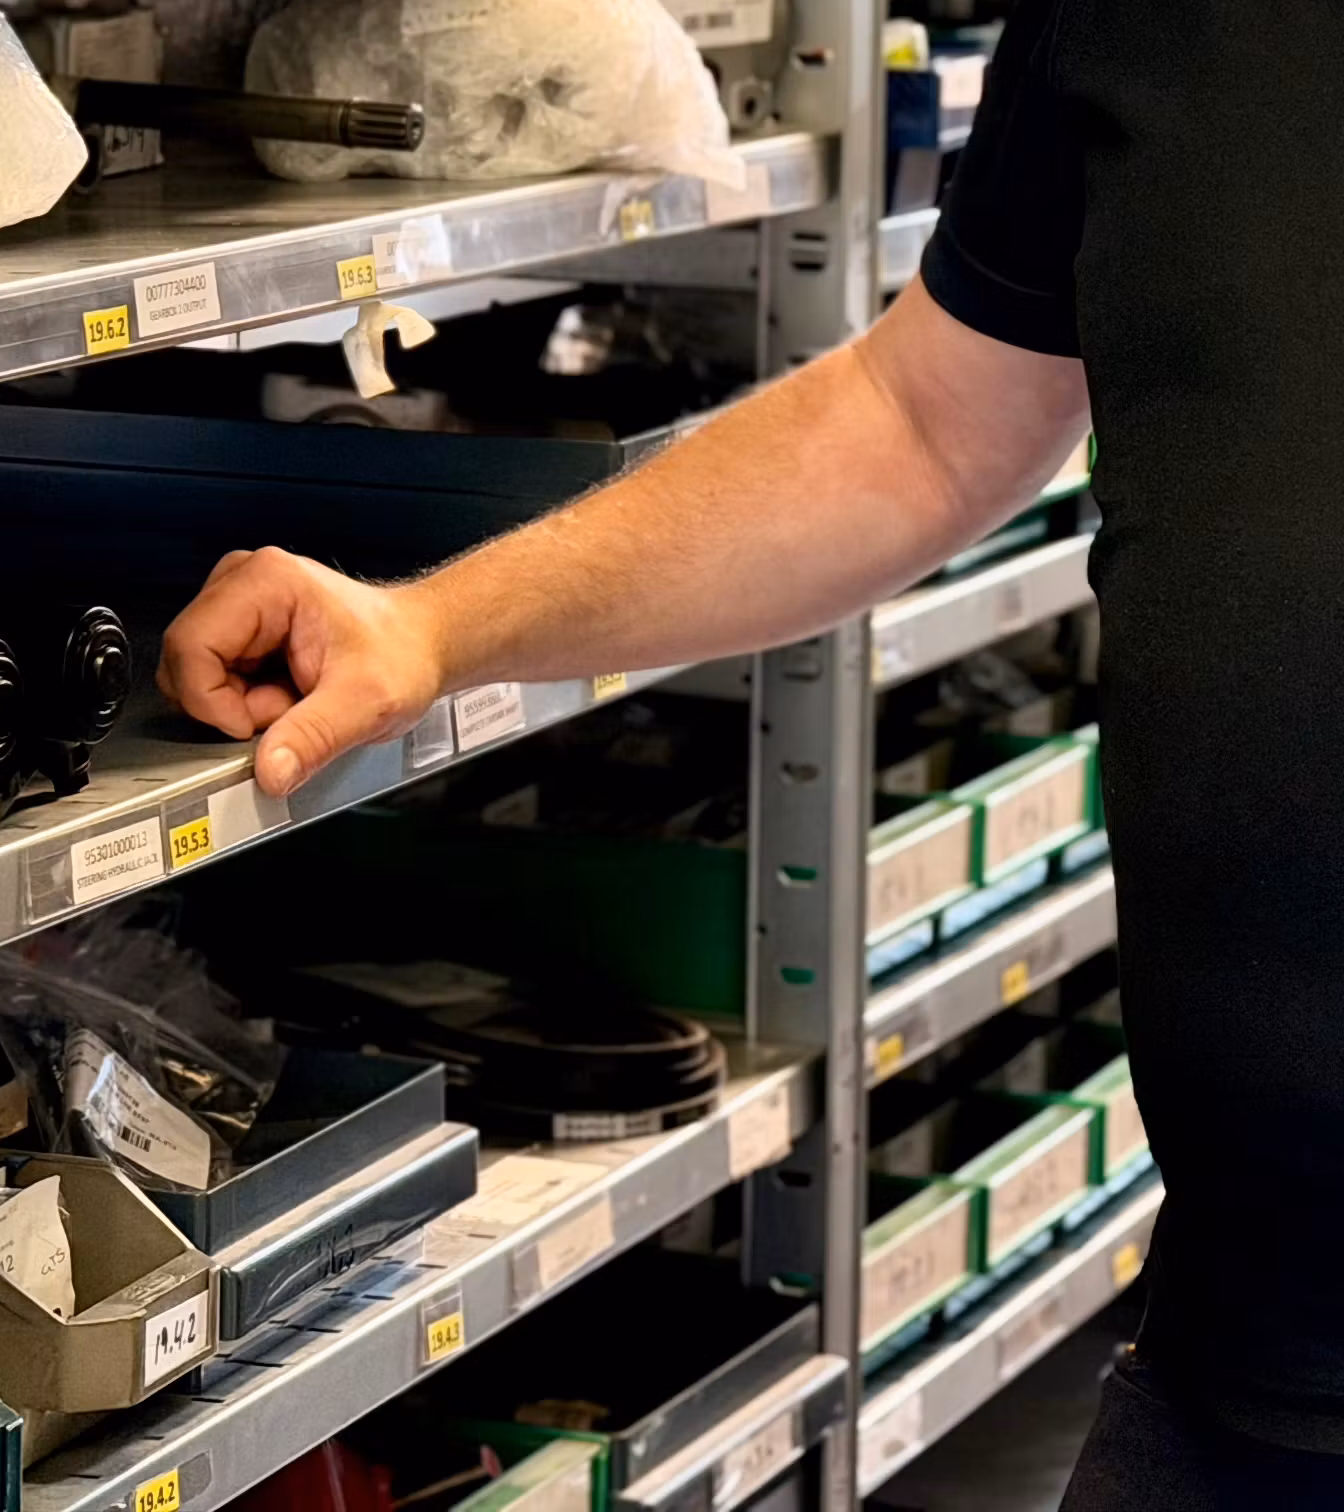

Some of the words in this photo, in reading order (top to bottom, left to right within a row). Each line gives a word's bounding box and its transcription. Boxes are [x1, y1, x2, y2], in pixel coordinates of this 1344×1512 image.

[88, 316, 126, 344] 19.6.2
[173, 827, 211, 859] 19.5.3
[139, 1480, 177, 1512] 19.4.2
